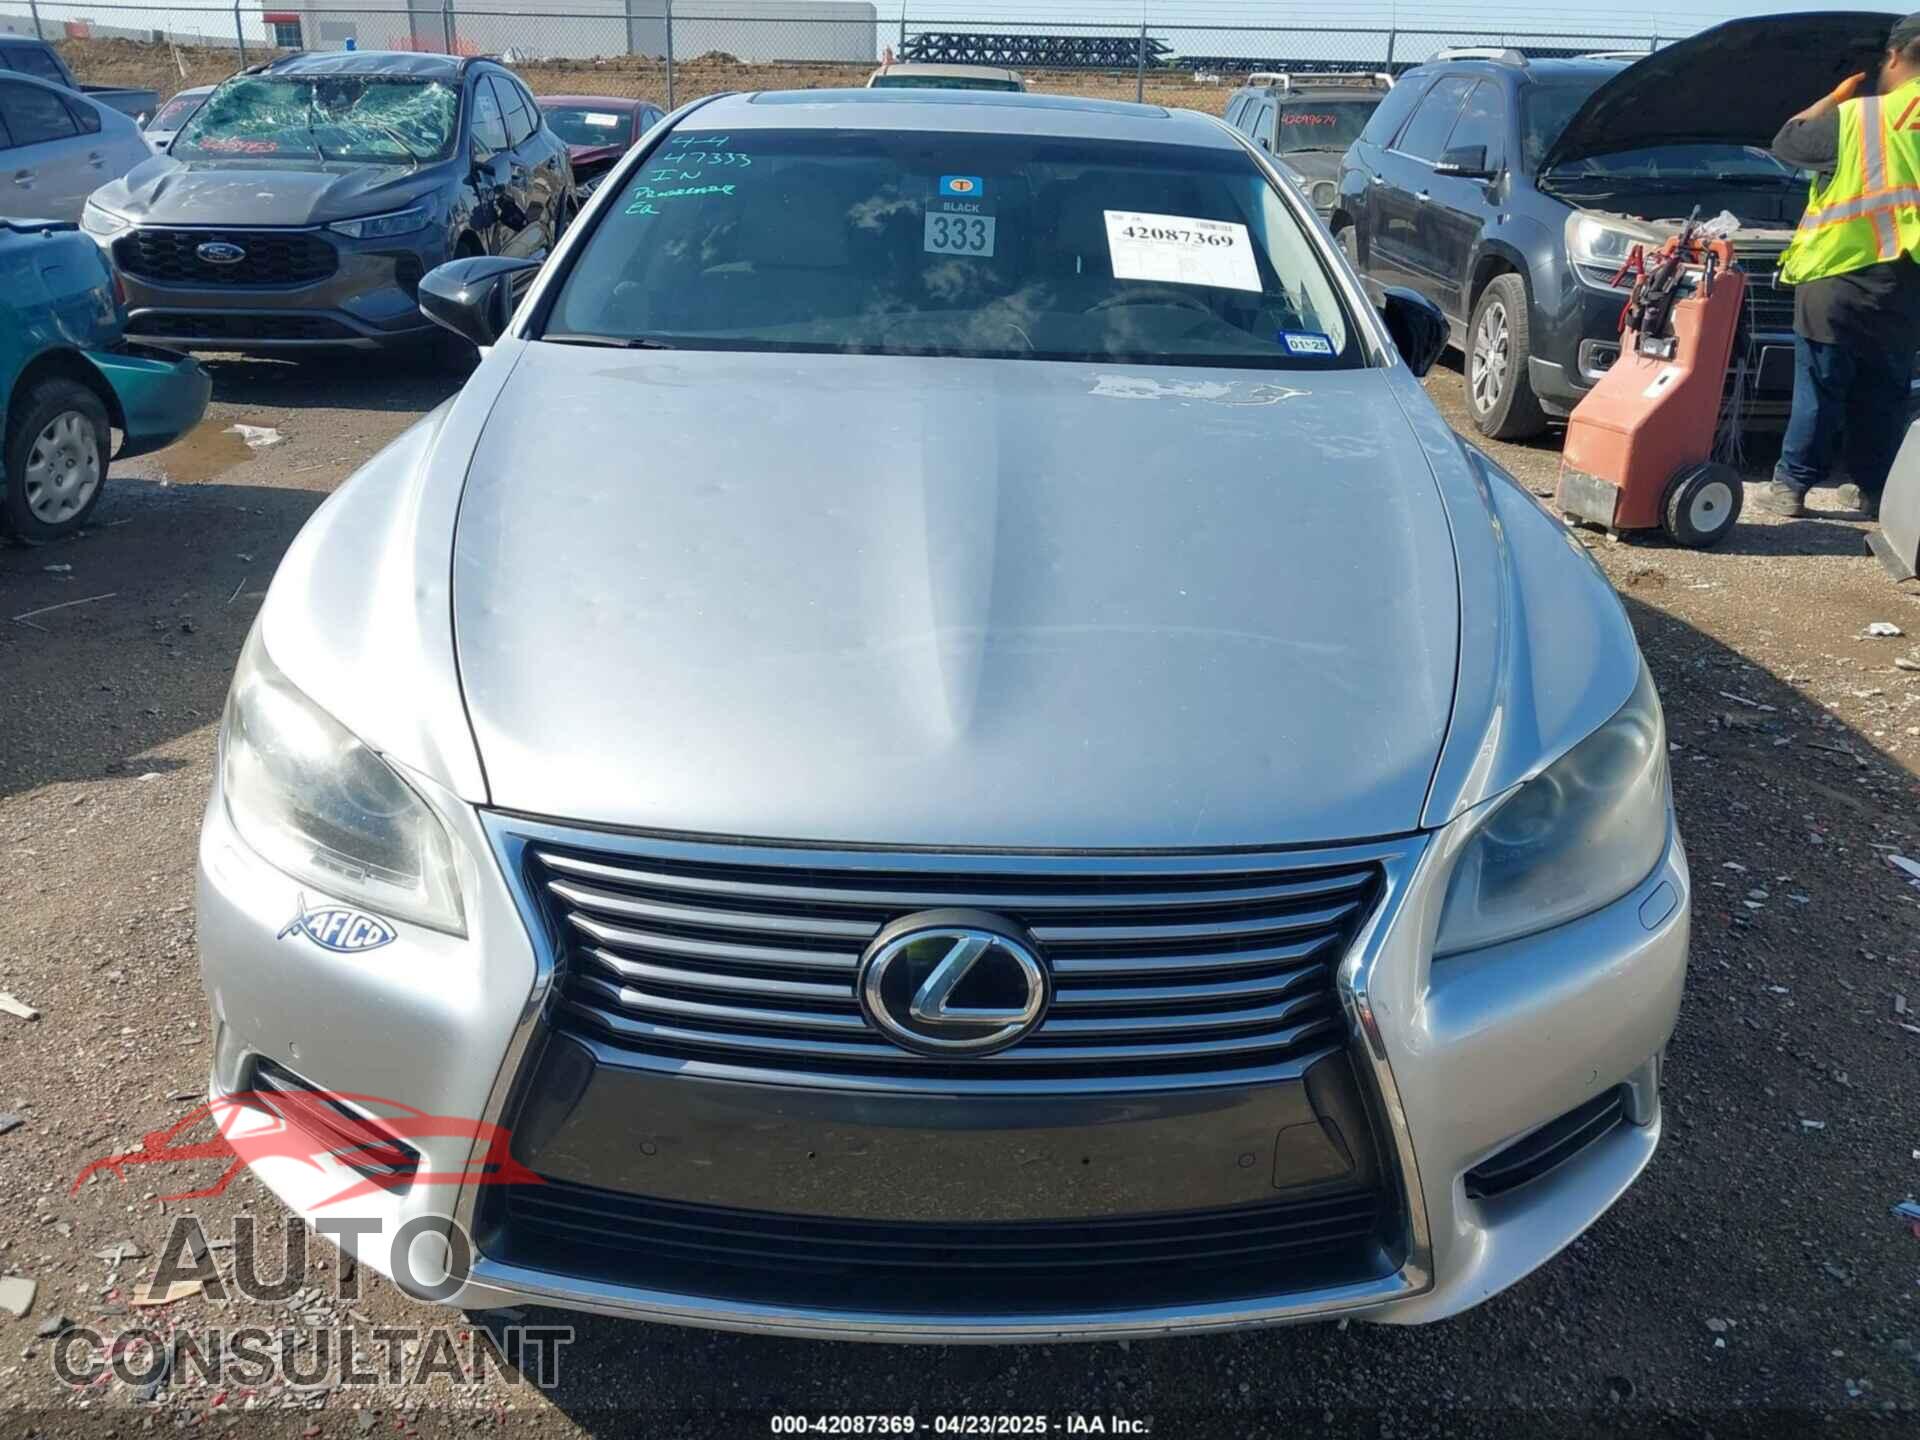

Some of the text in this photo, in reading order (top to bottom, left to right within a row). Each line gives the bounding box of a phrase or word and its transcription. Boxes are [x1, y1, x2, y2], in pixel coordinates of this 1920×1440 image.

[663, 152, 752, 168] 47333
[943, 201, 980, 213] BLACK
[932, 216, 987, 251] 333
[1121, 225, 1235, 248] 42087369
